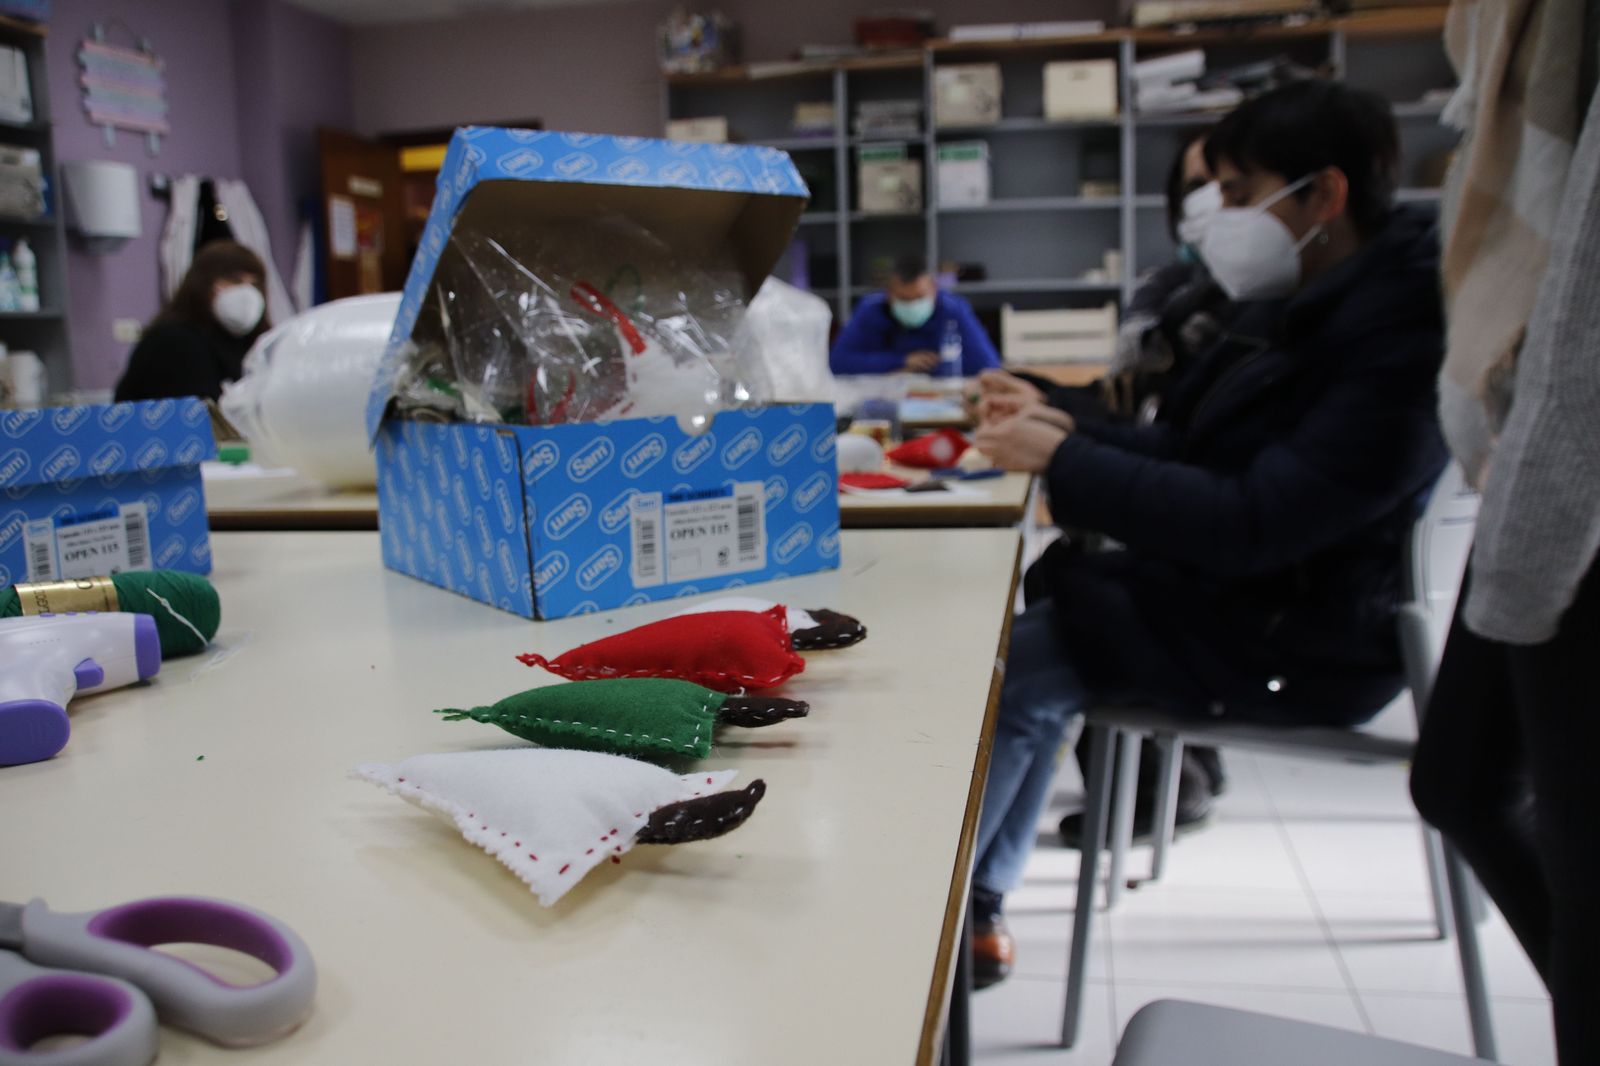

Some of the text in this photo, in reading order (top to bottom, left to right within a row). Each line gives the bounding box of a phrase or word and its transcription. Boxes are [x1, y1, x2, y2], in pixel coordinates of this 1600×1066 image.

[56, 406, 85, 430] Sam
[572, 444, 609, 477] Sam
[627, 438, 662, 470] Sam
[677, 437, 711, 468] Sam
[726, 432, 759, 462] Sam
[45, 449, 76, 478] Sam
[550, 498, 588, 532] Sam
[0, 518, 22, 546] am
[670, 525, 707, 541] OPEN
[64, 547, 98, 562] OPEN
[583, 549, 618, 582] Sam
